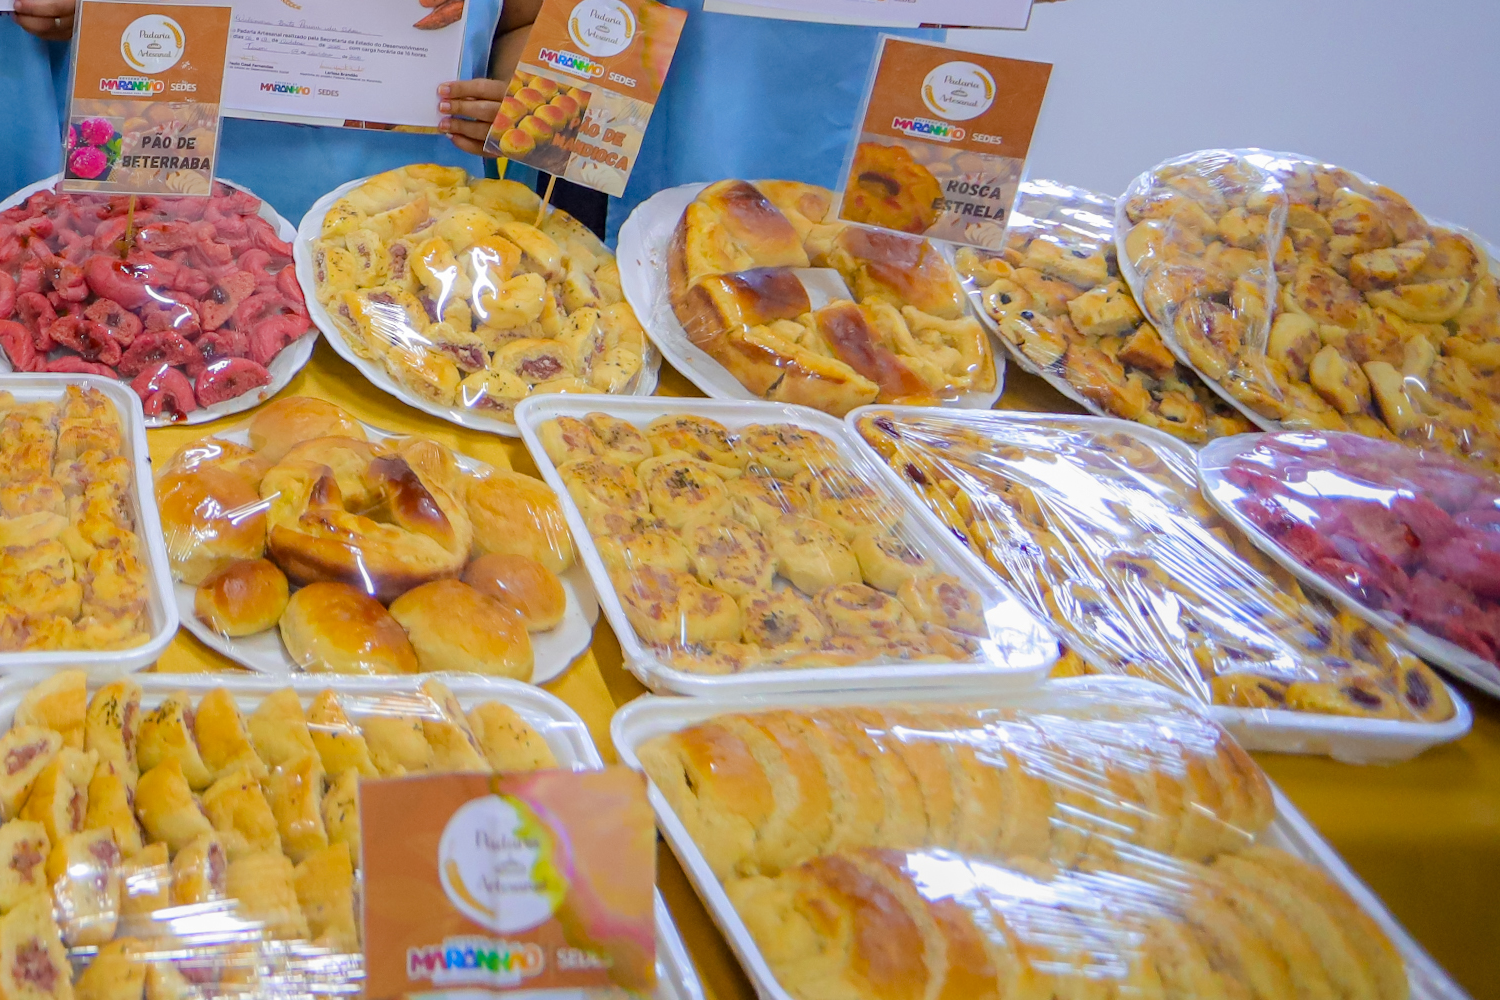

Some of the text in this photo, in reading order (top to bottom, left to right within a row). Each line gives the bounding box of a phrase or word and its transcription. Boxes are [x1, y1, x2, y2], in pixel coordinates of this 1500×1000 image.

[589, 9, 622, 26] Padaria
[139, 30, 170, 40] Padaria
[584, 29, 619, 45] Artesanal
[320, 36, 347, 44] Secretaria
[382, 43, 428, 52] Desenvolvimento
[138, 49, 172, 58] Artesanal
[170, 82, 197, 92] SEDES
[608, 72, 637, 87] SEDES
[944, 75, 980, 89] Padaria
[318, 88, 339, 97] SEDES
[939, 95, 978, 108] Artesanal
[569, 116, 627, 147] PÃO DE
[972, 133, 1003, 145] SEDES
[142, 132, 196, 150] PÃO DE
[552, 133, 629, 171] MANDIOCA
[122, 156, 211, 170] BETERRABA
[946, 180, 1001, 200] ROSCA
[932, 197, 1005, 221] ESTRELA
